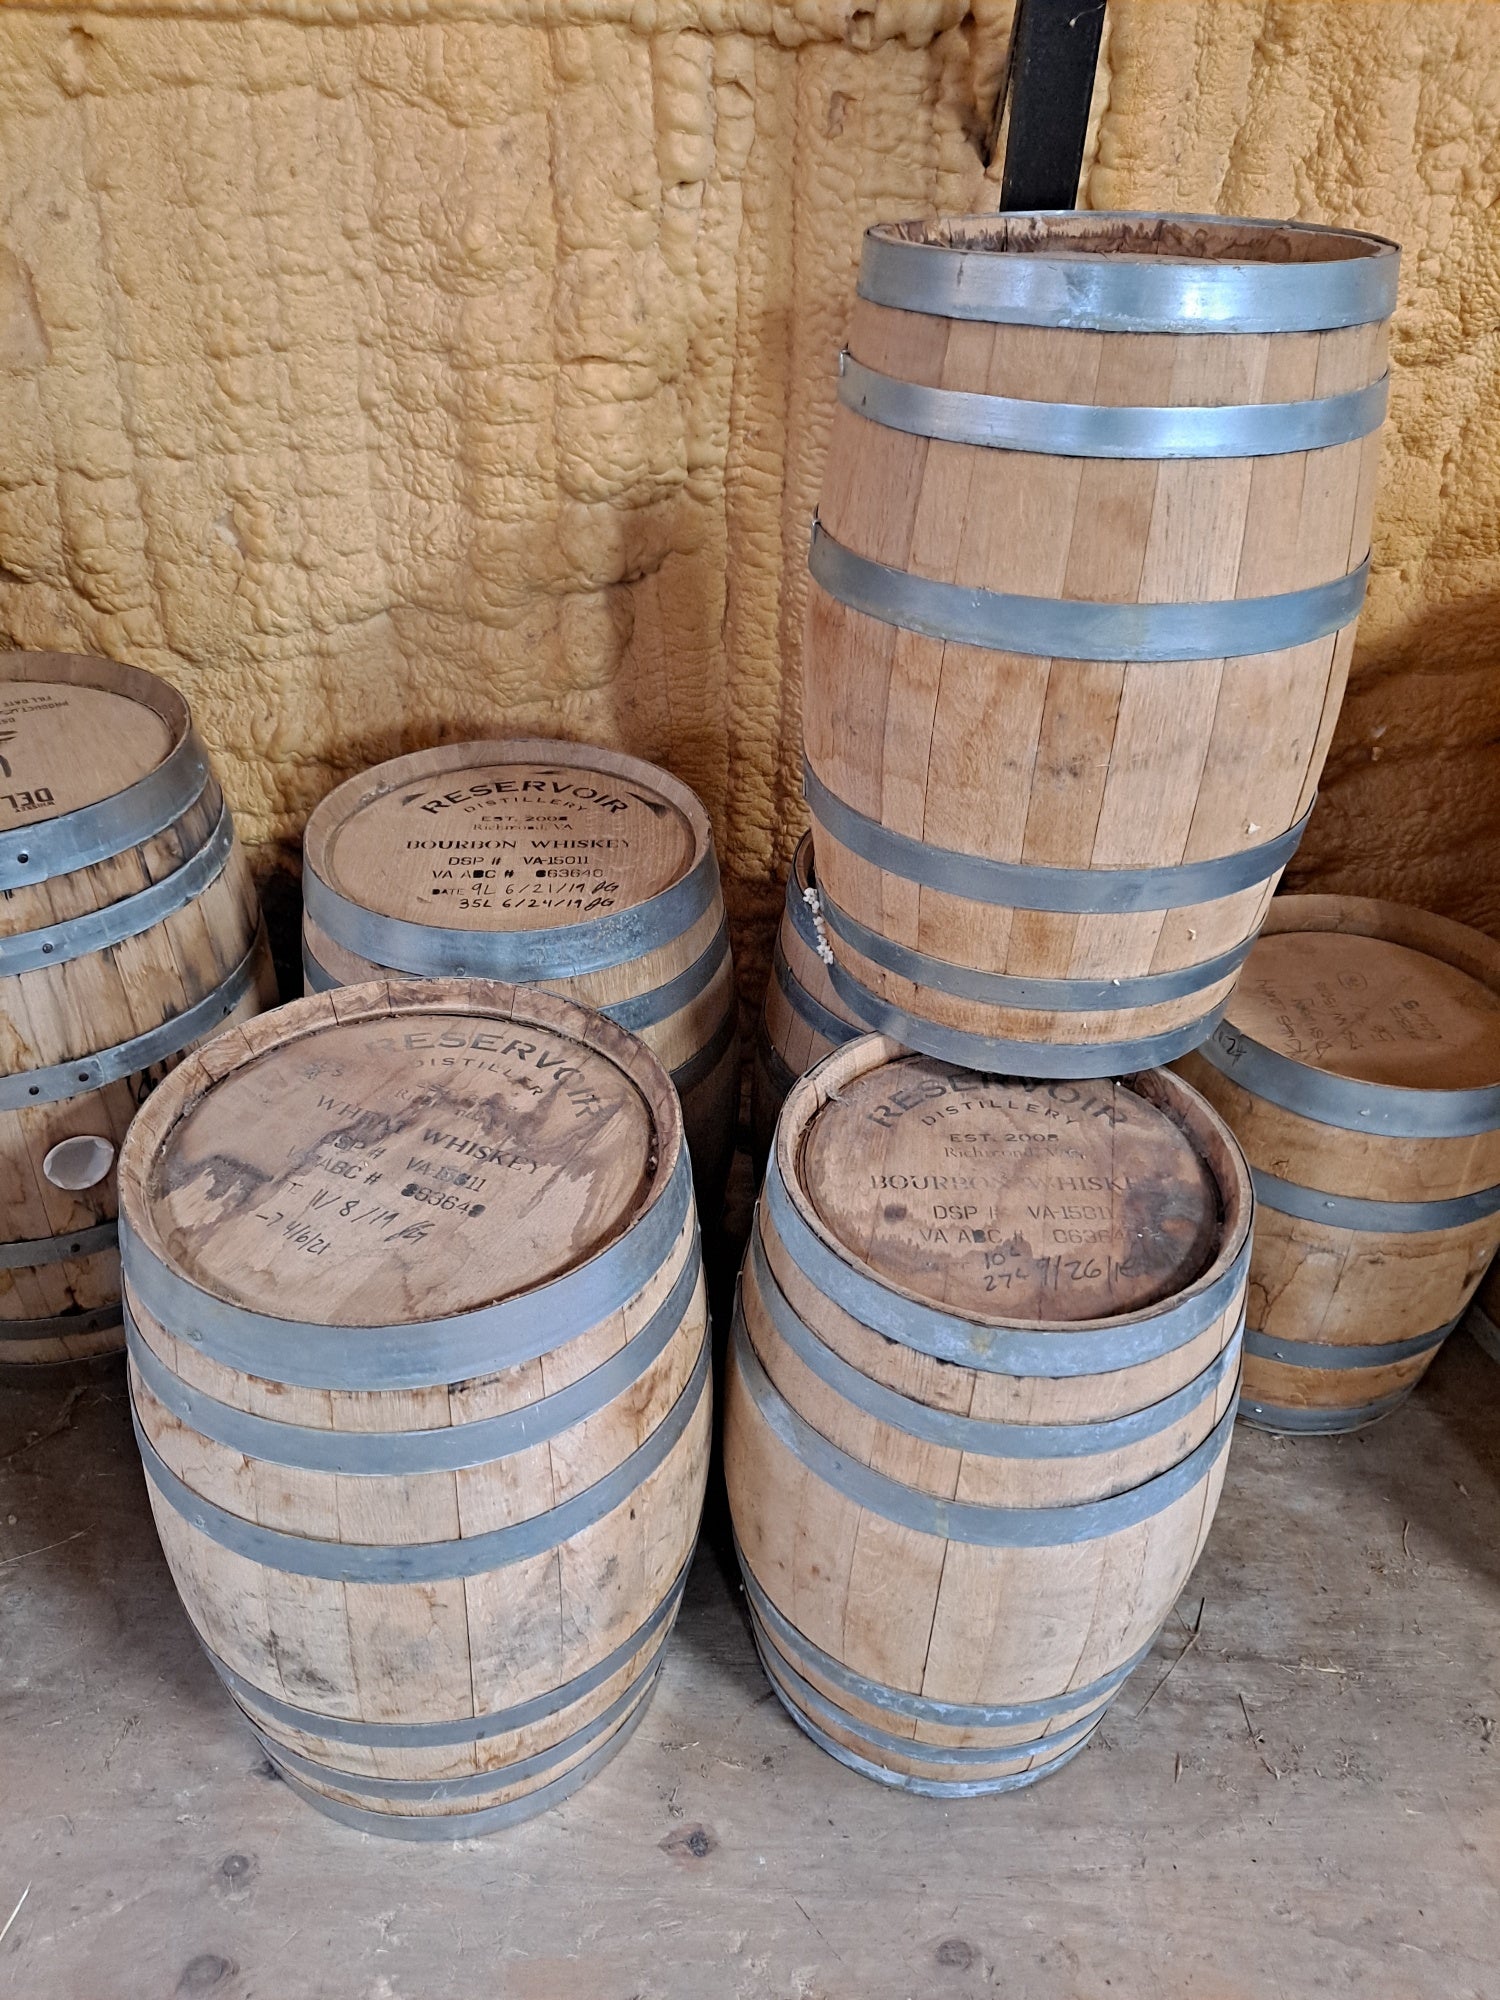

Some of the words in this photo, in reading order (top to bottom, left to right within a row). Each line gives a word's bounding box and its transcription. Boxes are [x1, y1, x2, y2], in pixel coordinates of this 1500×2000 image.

[0, 787, 55, 810] DEL
[420, 780, 629, 815] RESERVOIR
[463, 796, 588, 814] DISTILLERY
[14, 800, 56, 813] WHISKEY
[406, 839, 517, 850] BOURBON
[531, 838, 632, 850] WHISKEY
[448, 856, 485, 866] DSP
[523, 855, 590, 867] VA-15011
[431, 869, 454, 879] VA
[368, 1031, 603, 1119] RESERVOIR
[920, 1100, 1079, 1127] DISTILLERY
[422, 1128, 544, 1175] WHISKEY
[932, 1205, 978, 1220] DSP
[919, 1229, 948, 1244] VA
